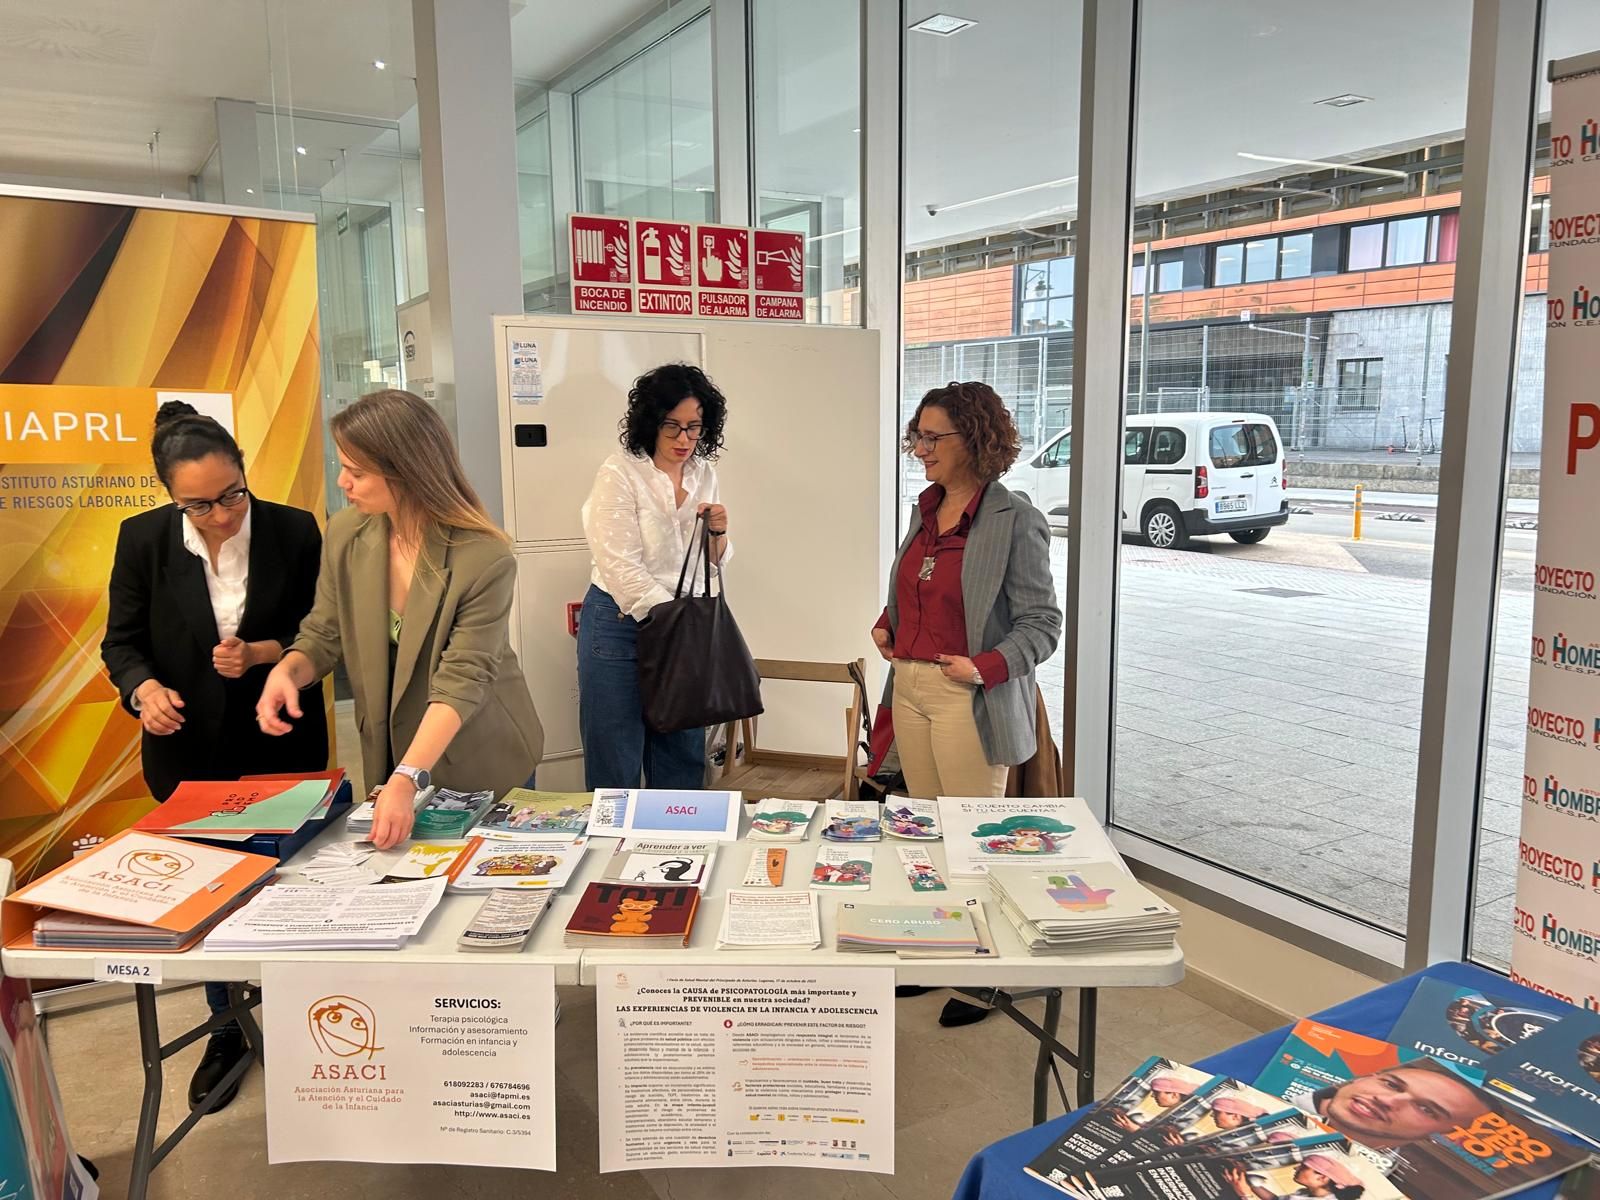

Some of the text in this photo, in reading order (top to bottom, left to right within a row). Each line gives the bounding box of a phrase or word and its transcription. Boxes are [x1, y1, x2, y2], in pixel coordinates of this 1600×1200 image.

[1581, 119, 1600, 155] H
[581, 289, 625, 300] BOCA DE
[701, 294, 746, 305] PULSADOR
[580, 300, 627, 311] INCENDIO
[640, 293, 691, 311] EXTINTOR
[760, 297, 798, 308] CAMPANA
[700, 305, 747, 317] DE ALARMA
[757, 308, 801, 319] DE ALARMA
[5, 410, 137, 442] IAPRL
[1567, 402, 1600, 476] P
[1, 475, 156, 490] STITUTO ASTURIANO DE
[13, 496, 74, 509] RIESGOS
[79, 495, 156, 508] LABORALES
[665, 806, 697, 815] ASACI
[637, 843, 681, 851] Aprender
[1519, 838, 1583, 882] ROYECTO
[89, 871, 174, 892] ASACI
[595, 885, 688, 906] TOTI
[870, 917, 941, 926] CERO ABUSO
[107, 964, 150, 977] MESA 2
[637, 987, 671, 995] ¿Conoces
[721, 987, 788, 995] PSICOPATOLOGÍA
[434, 998, 501, 1009] SERVICIOS:
[430, 1015, 508, 1025] Terapia psicológica
[409, 1025, 528, 1035] Información y asesoramiento
[421, 1036, 465, 1044] Formación
[479, 1037, 511, 1045] infancia
[442, 1048, 497, 1057] adolescencia
[311, 1064, 386, 1080] ASACI
[443, 1081, 484, 1089] 618092283
[294, 1086, 404, 1096] Asociación Asturiana para
[470, 1092, 530, 1100] asaci@fapmi.es
[308, 1094, 346, 1102] Atención
[366, 1095, 401, 1103] Cuidado
[345, 1103, 378, 1111] Infancia
[432, 1100, 530, 1110] asaciasturias@gmail.com
[454, 1110, 530, 1120] http://www.asaci.es
[1475, 1111, 1552, 1158] PRO
[1467, 1119, 1536, 1165] YEC
